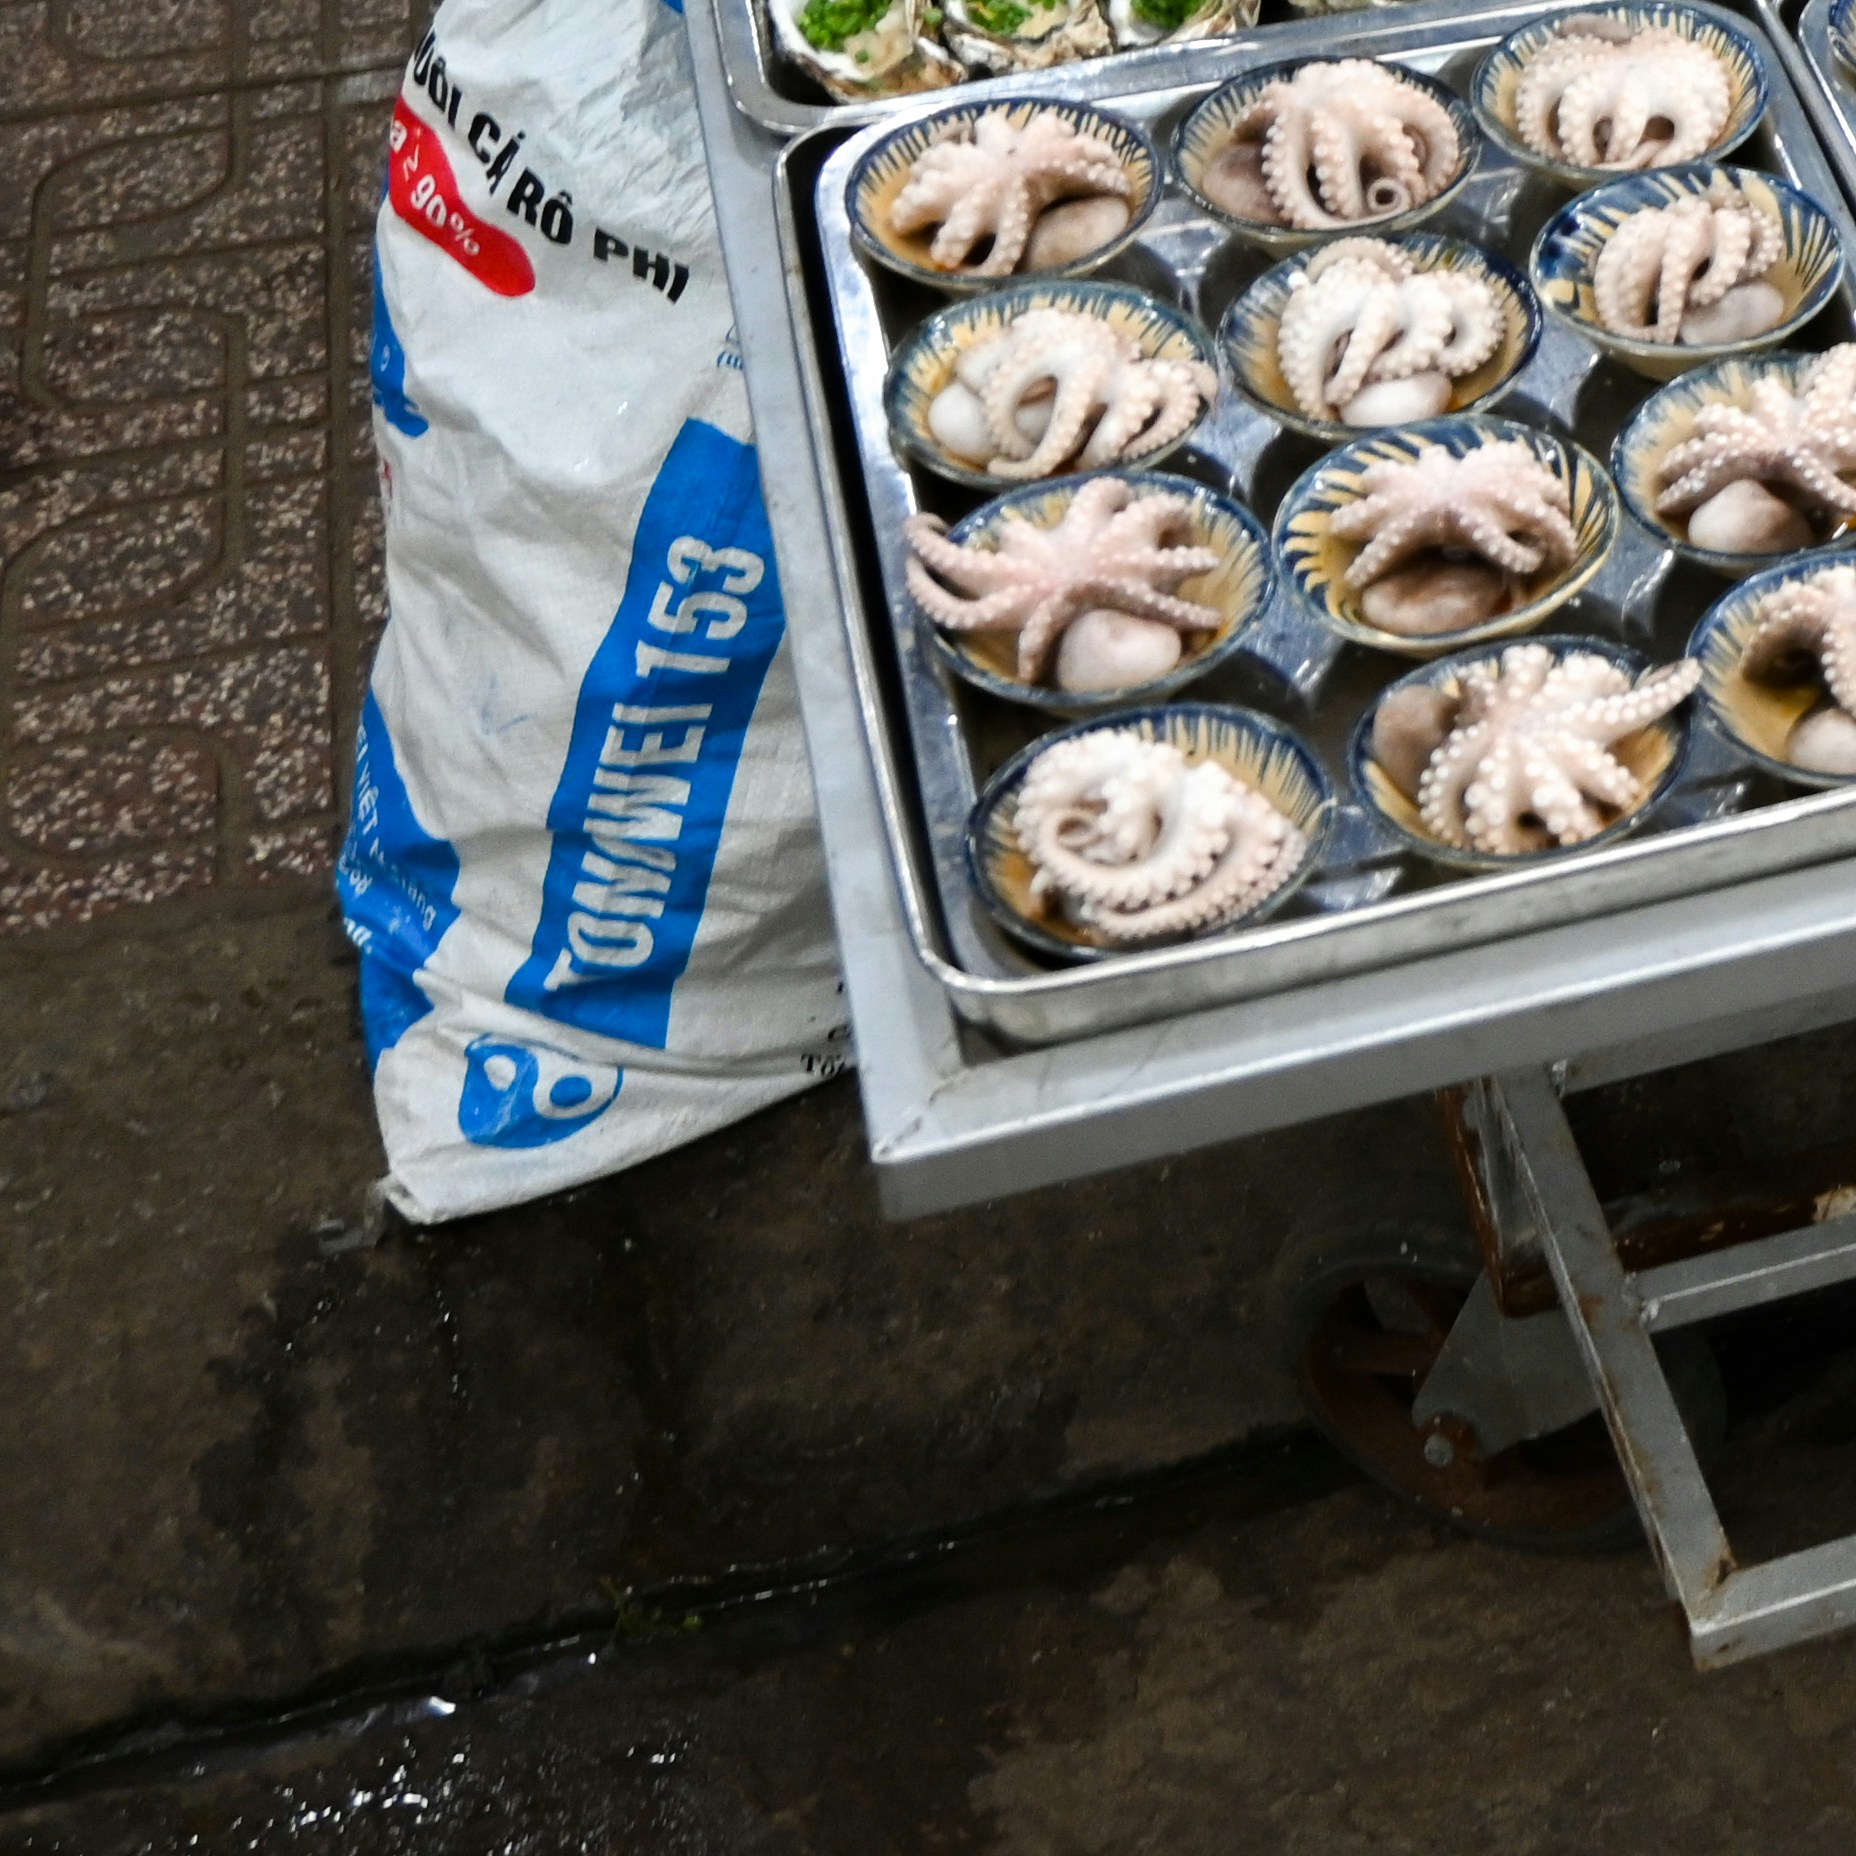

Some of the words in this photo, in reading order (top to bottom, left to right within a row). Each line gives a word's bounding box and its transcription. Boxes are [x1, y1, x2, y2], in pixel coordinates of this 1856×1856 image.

[410, 174, 480, 256] 90%
[415, 29, 461, 130] UÔI
[468, 111, 526, 196] CÁ
[506, 166, 573, 245] RÔ
[594, 227, 689, 305] PHI
[635, 535, 765, 678] 153
